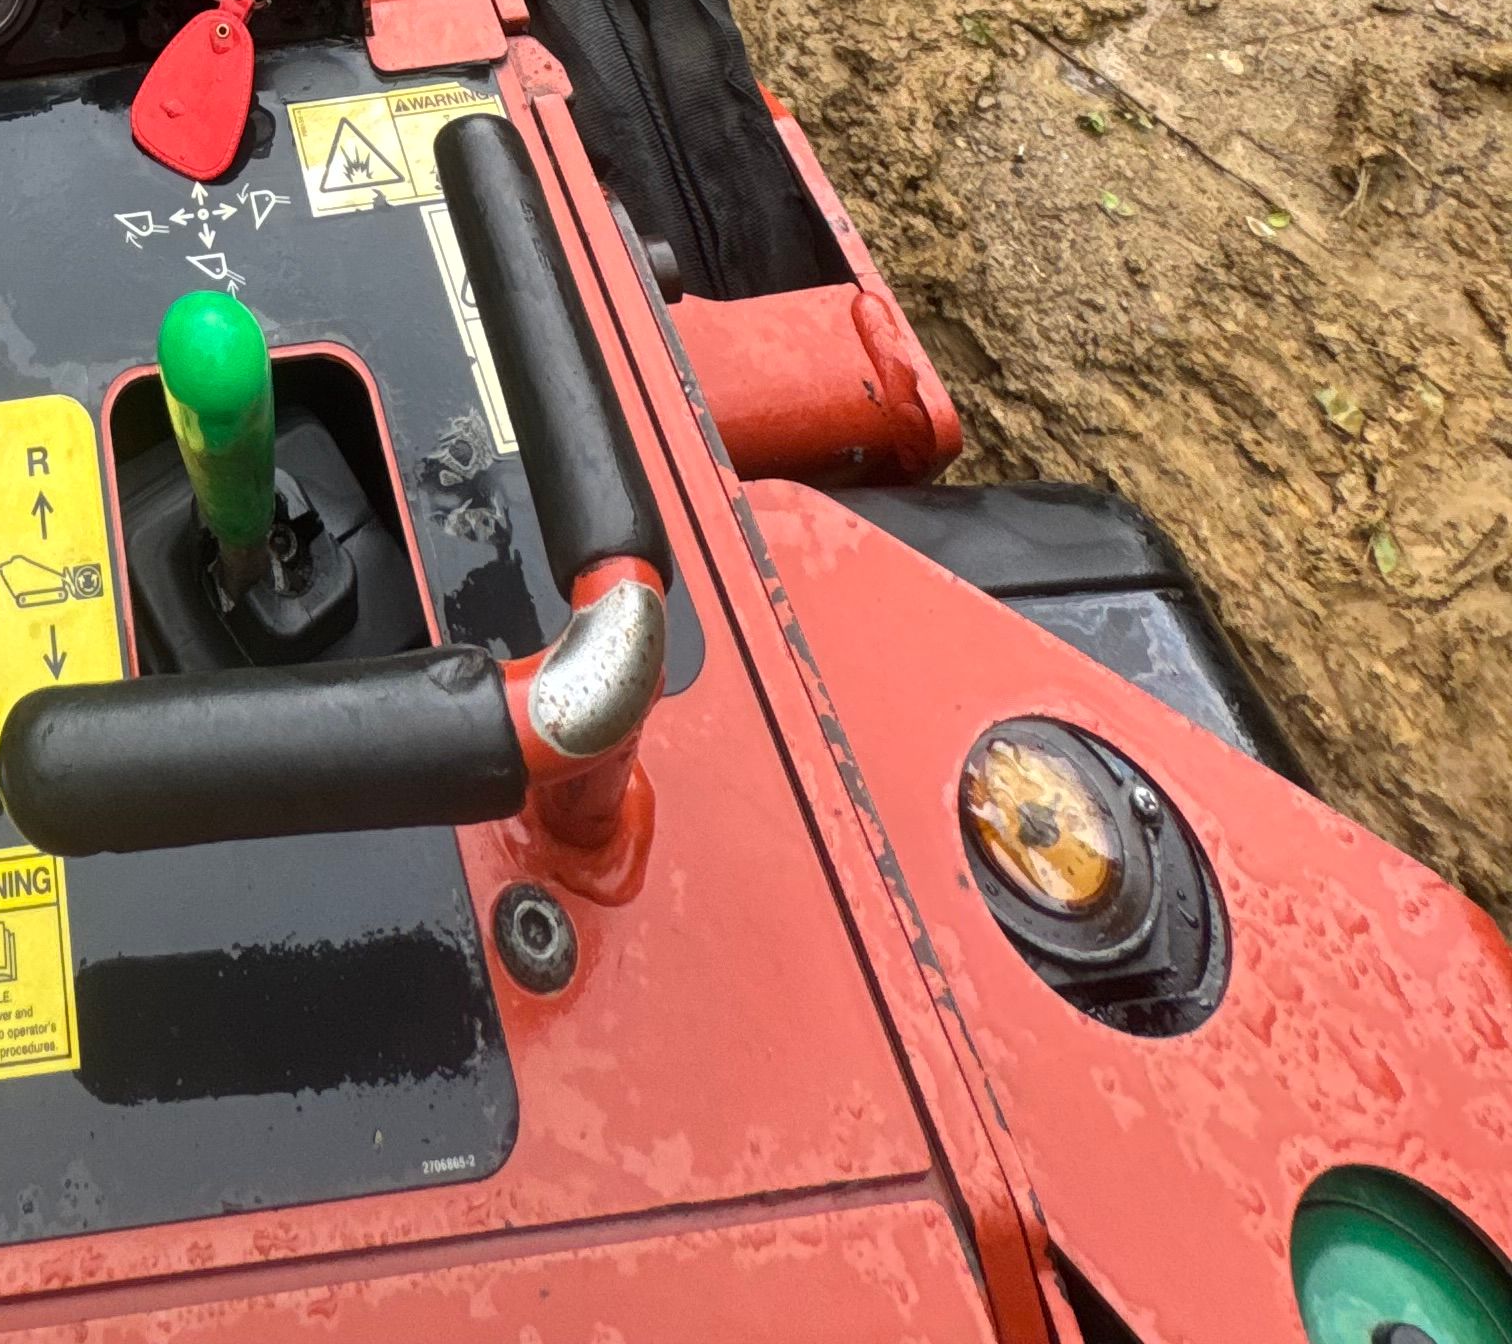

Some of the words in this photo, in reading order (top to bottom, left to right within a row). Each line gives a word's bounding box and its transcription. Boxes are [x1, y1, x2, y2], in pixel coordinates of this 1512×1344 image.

[27, 446, 51, 477] R
[15, 1006, 33, 1020] and
[7, 1021, 57, 1041] operator's
[0, 1040, 59, 1058] procedures.
